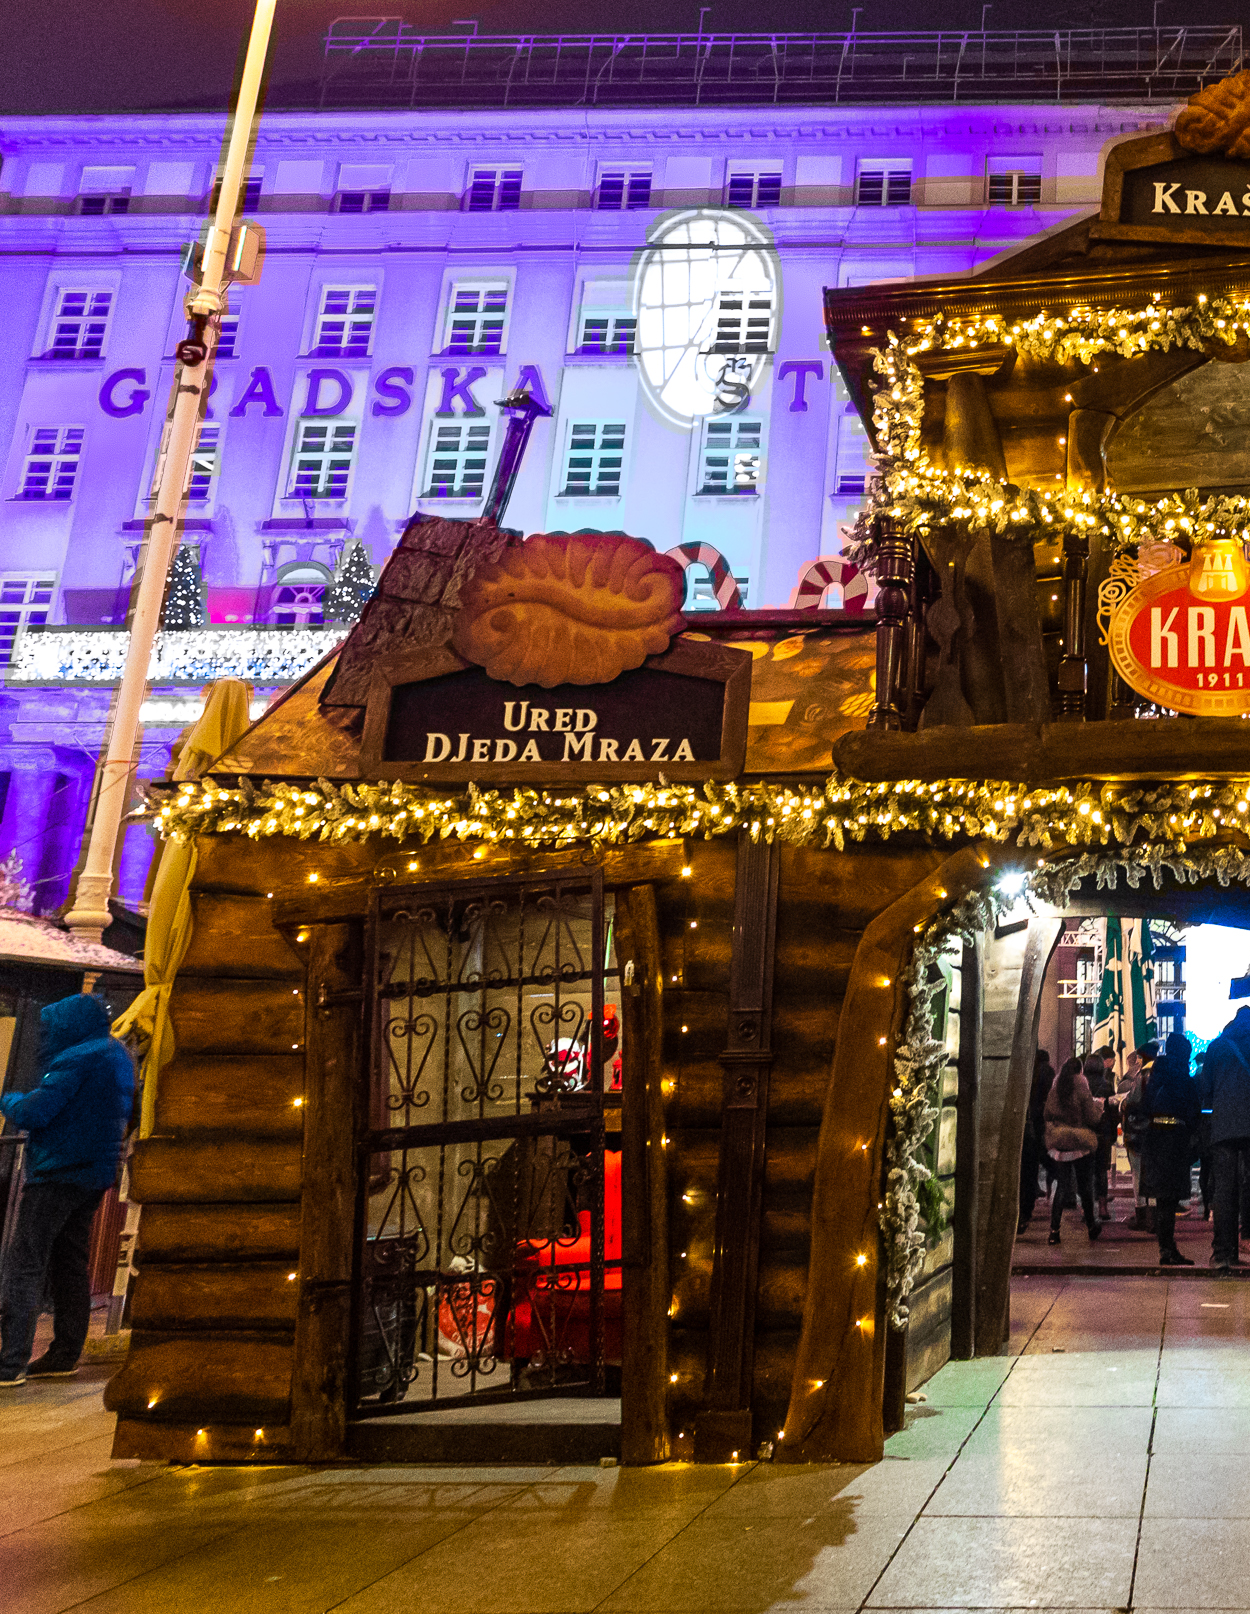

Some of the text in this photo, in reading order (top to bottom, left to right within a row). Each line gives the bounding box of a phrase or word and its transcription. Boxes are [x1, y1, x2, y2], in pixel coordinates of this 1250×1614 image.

[1196, 673, 1244, 688] 1911
[503, 701, 598, 732] URED
[560, 732, 696, 762] MRAZA
